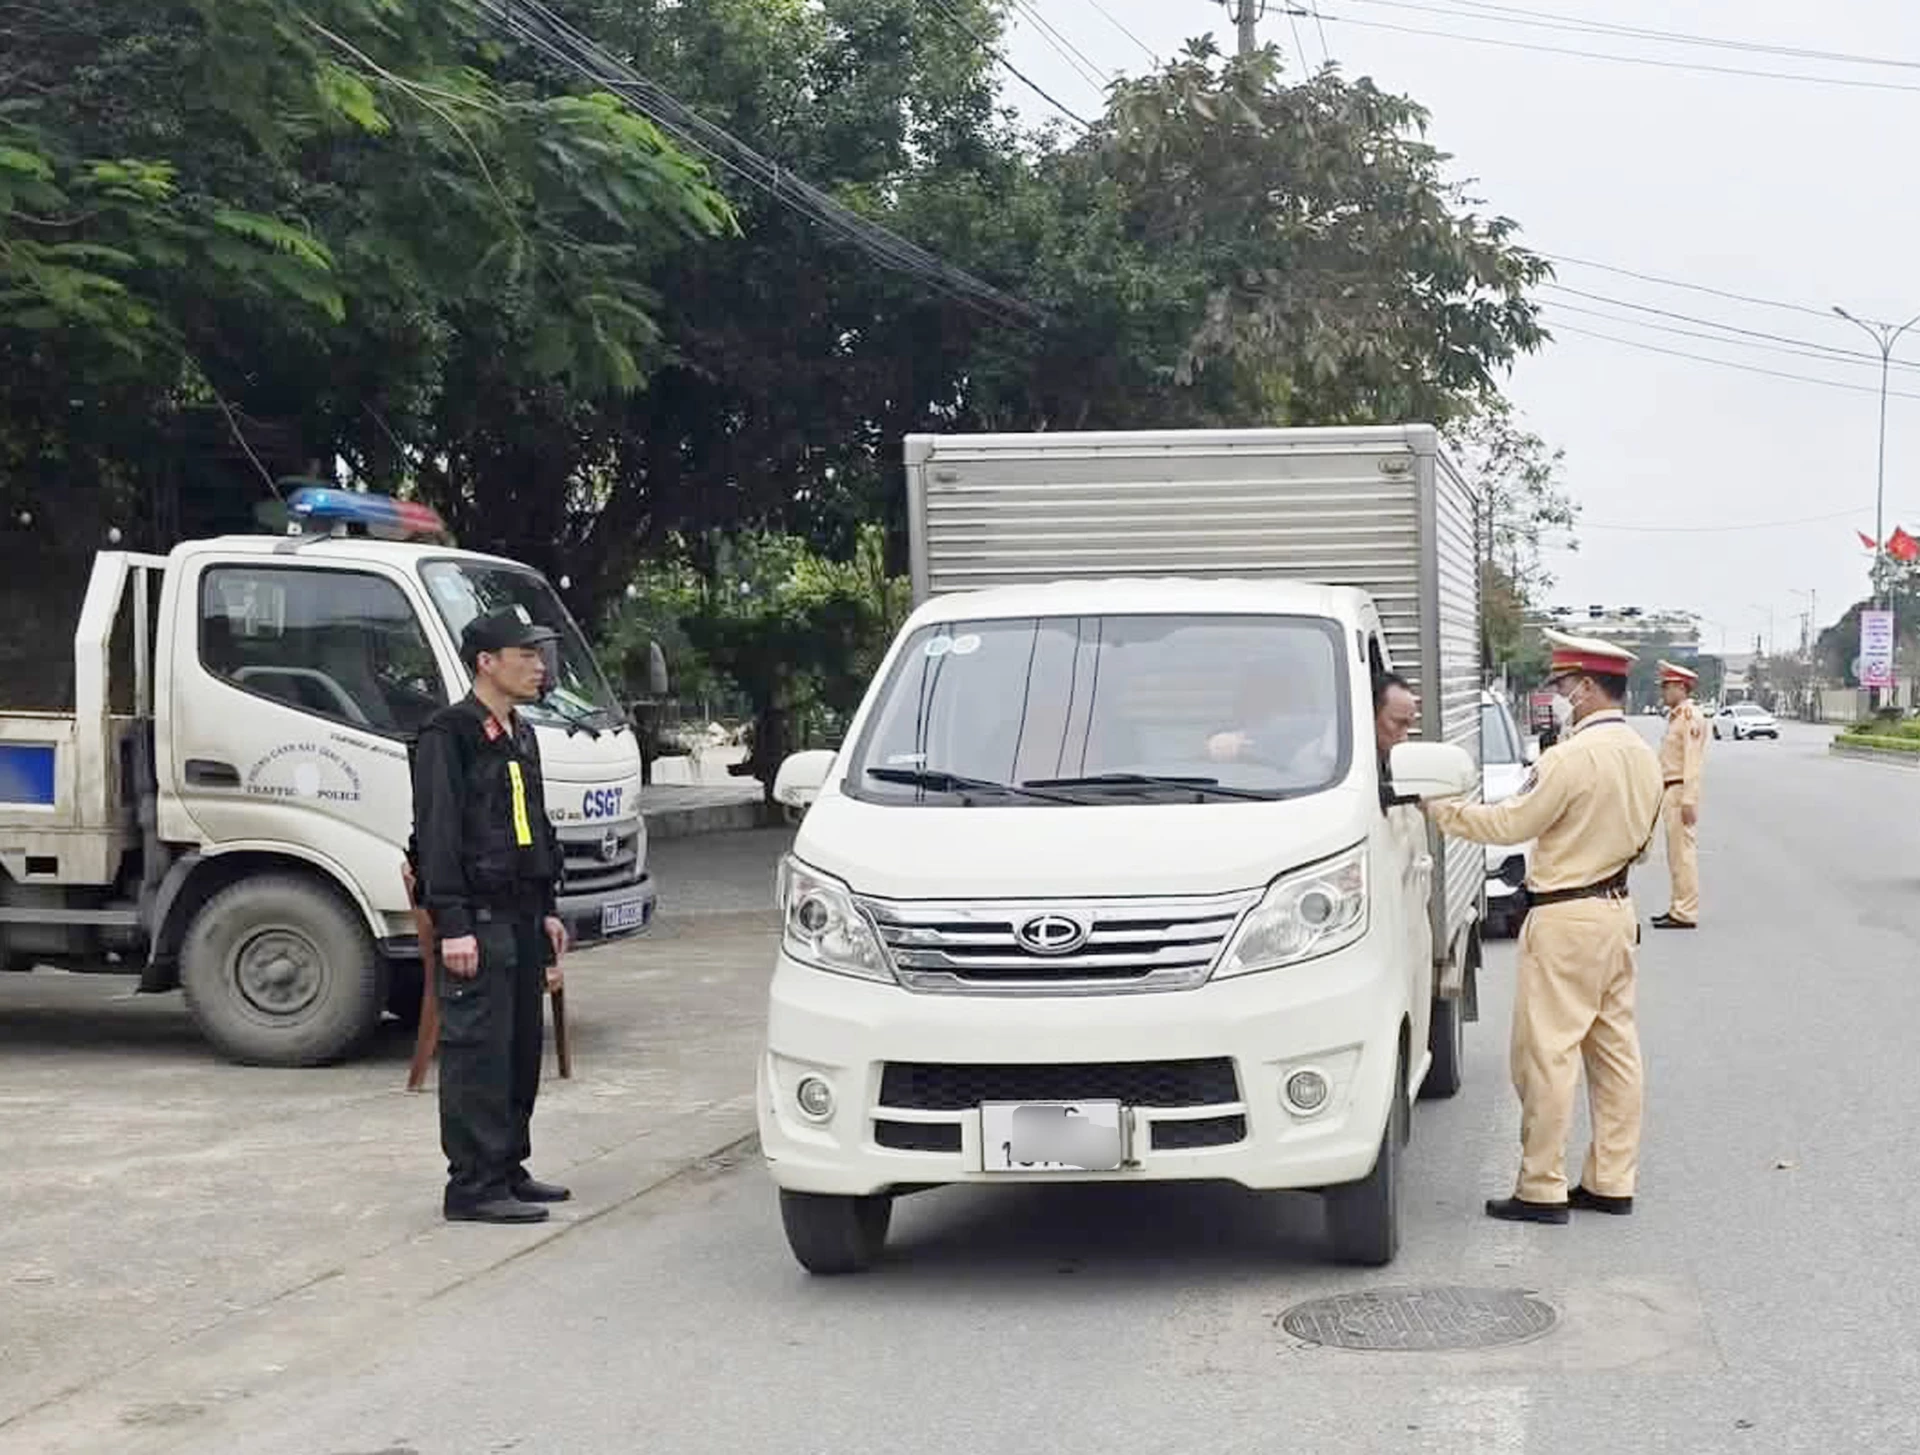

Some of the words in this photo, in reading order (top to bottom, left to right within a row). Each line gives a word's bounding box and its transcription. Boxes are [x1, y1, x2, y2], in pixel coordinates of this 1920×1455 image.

[246, 783, 298, 796] TRAFFIC
[317, 789, 361, 801] POLICE
[583, 787, 622, 818] CSGT
